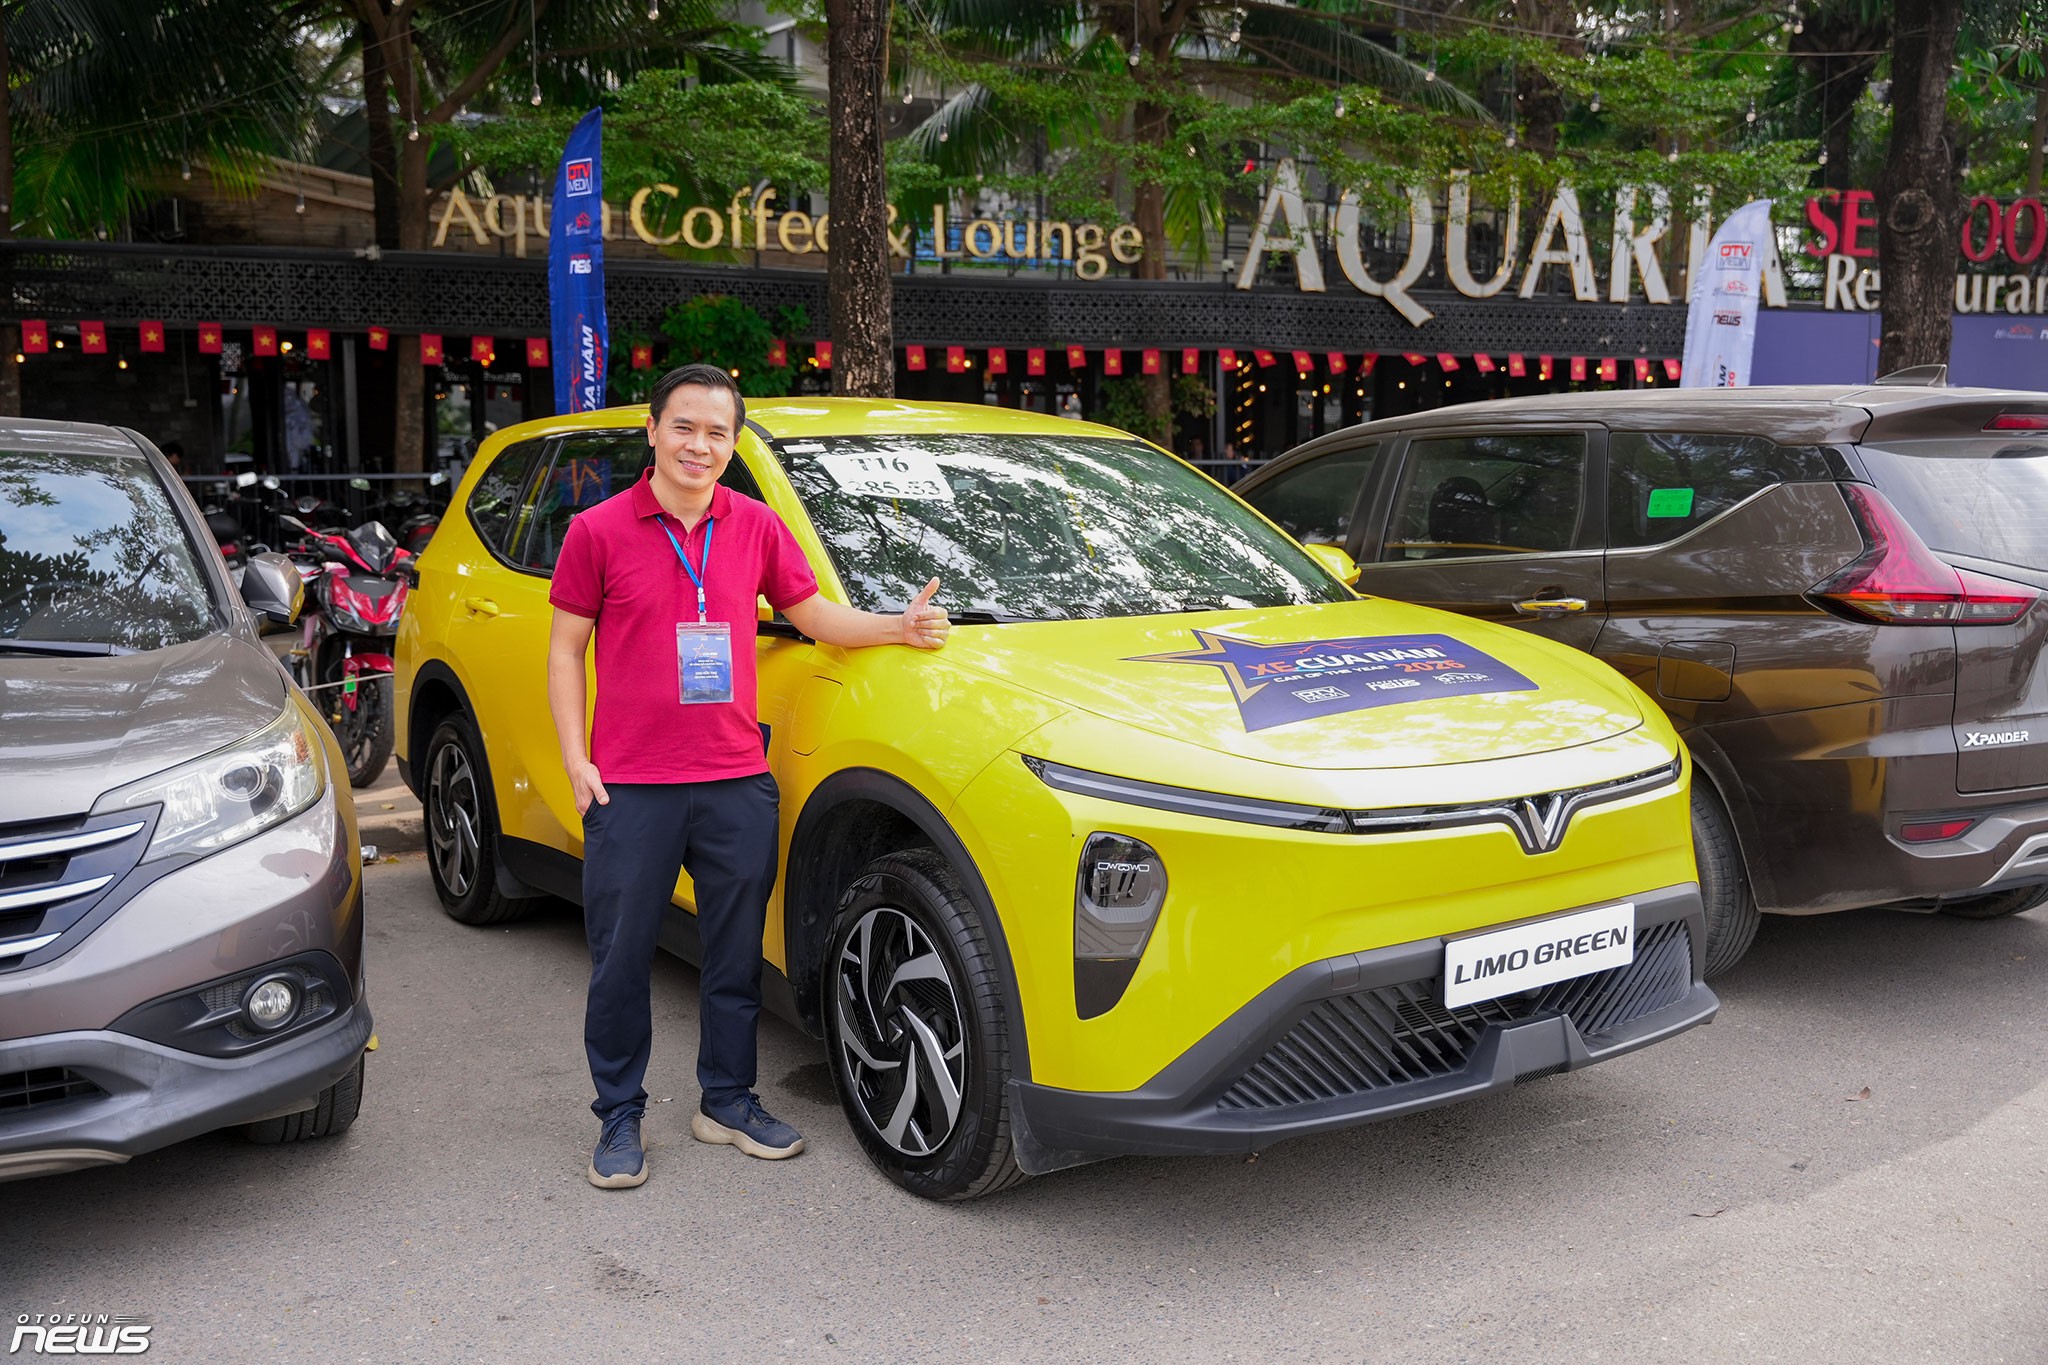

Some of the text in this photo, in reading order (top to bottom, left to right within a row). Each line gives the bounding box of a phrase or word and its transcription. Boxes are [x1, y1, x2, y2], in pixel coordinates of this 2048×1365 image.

[933, 204, 1144, 281] Lounge
[1720, 244, 1750, 257] OTV
[850, 457, 909, 473] T16
[1245, 661, 1298, 676] XE
[1363, 648, 1447, 662] NĂM
[1394, 659, 1467, 673] 2026
[1273, 673, 1303, 683] CAR
[1353, 664, 1390, 672] YEAR
[1963, 730, 2029, 747] XPANDER
[1454, 926, 1628, 985] LIMO GREEN
